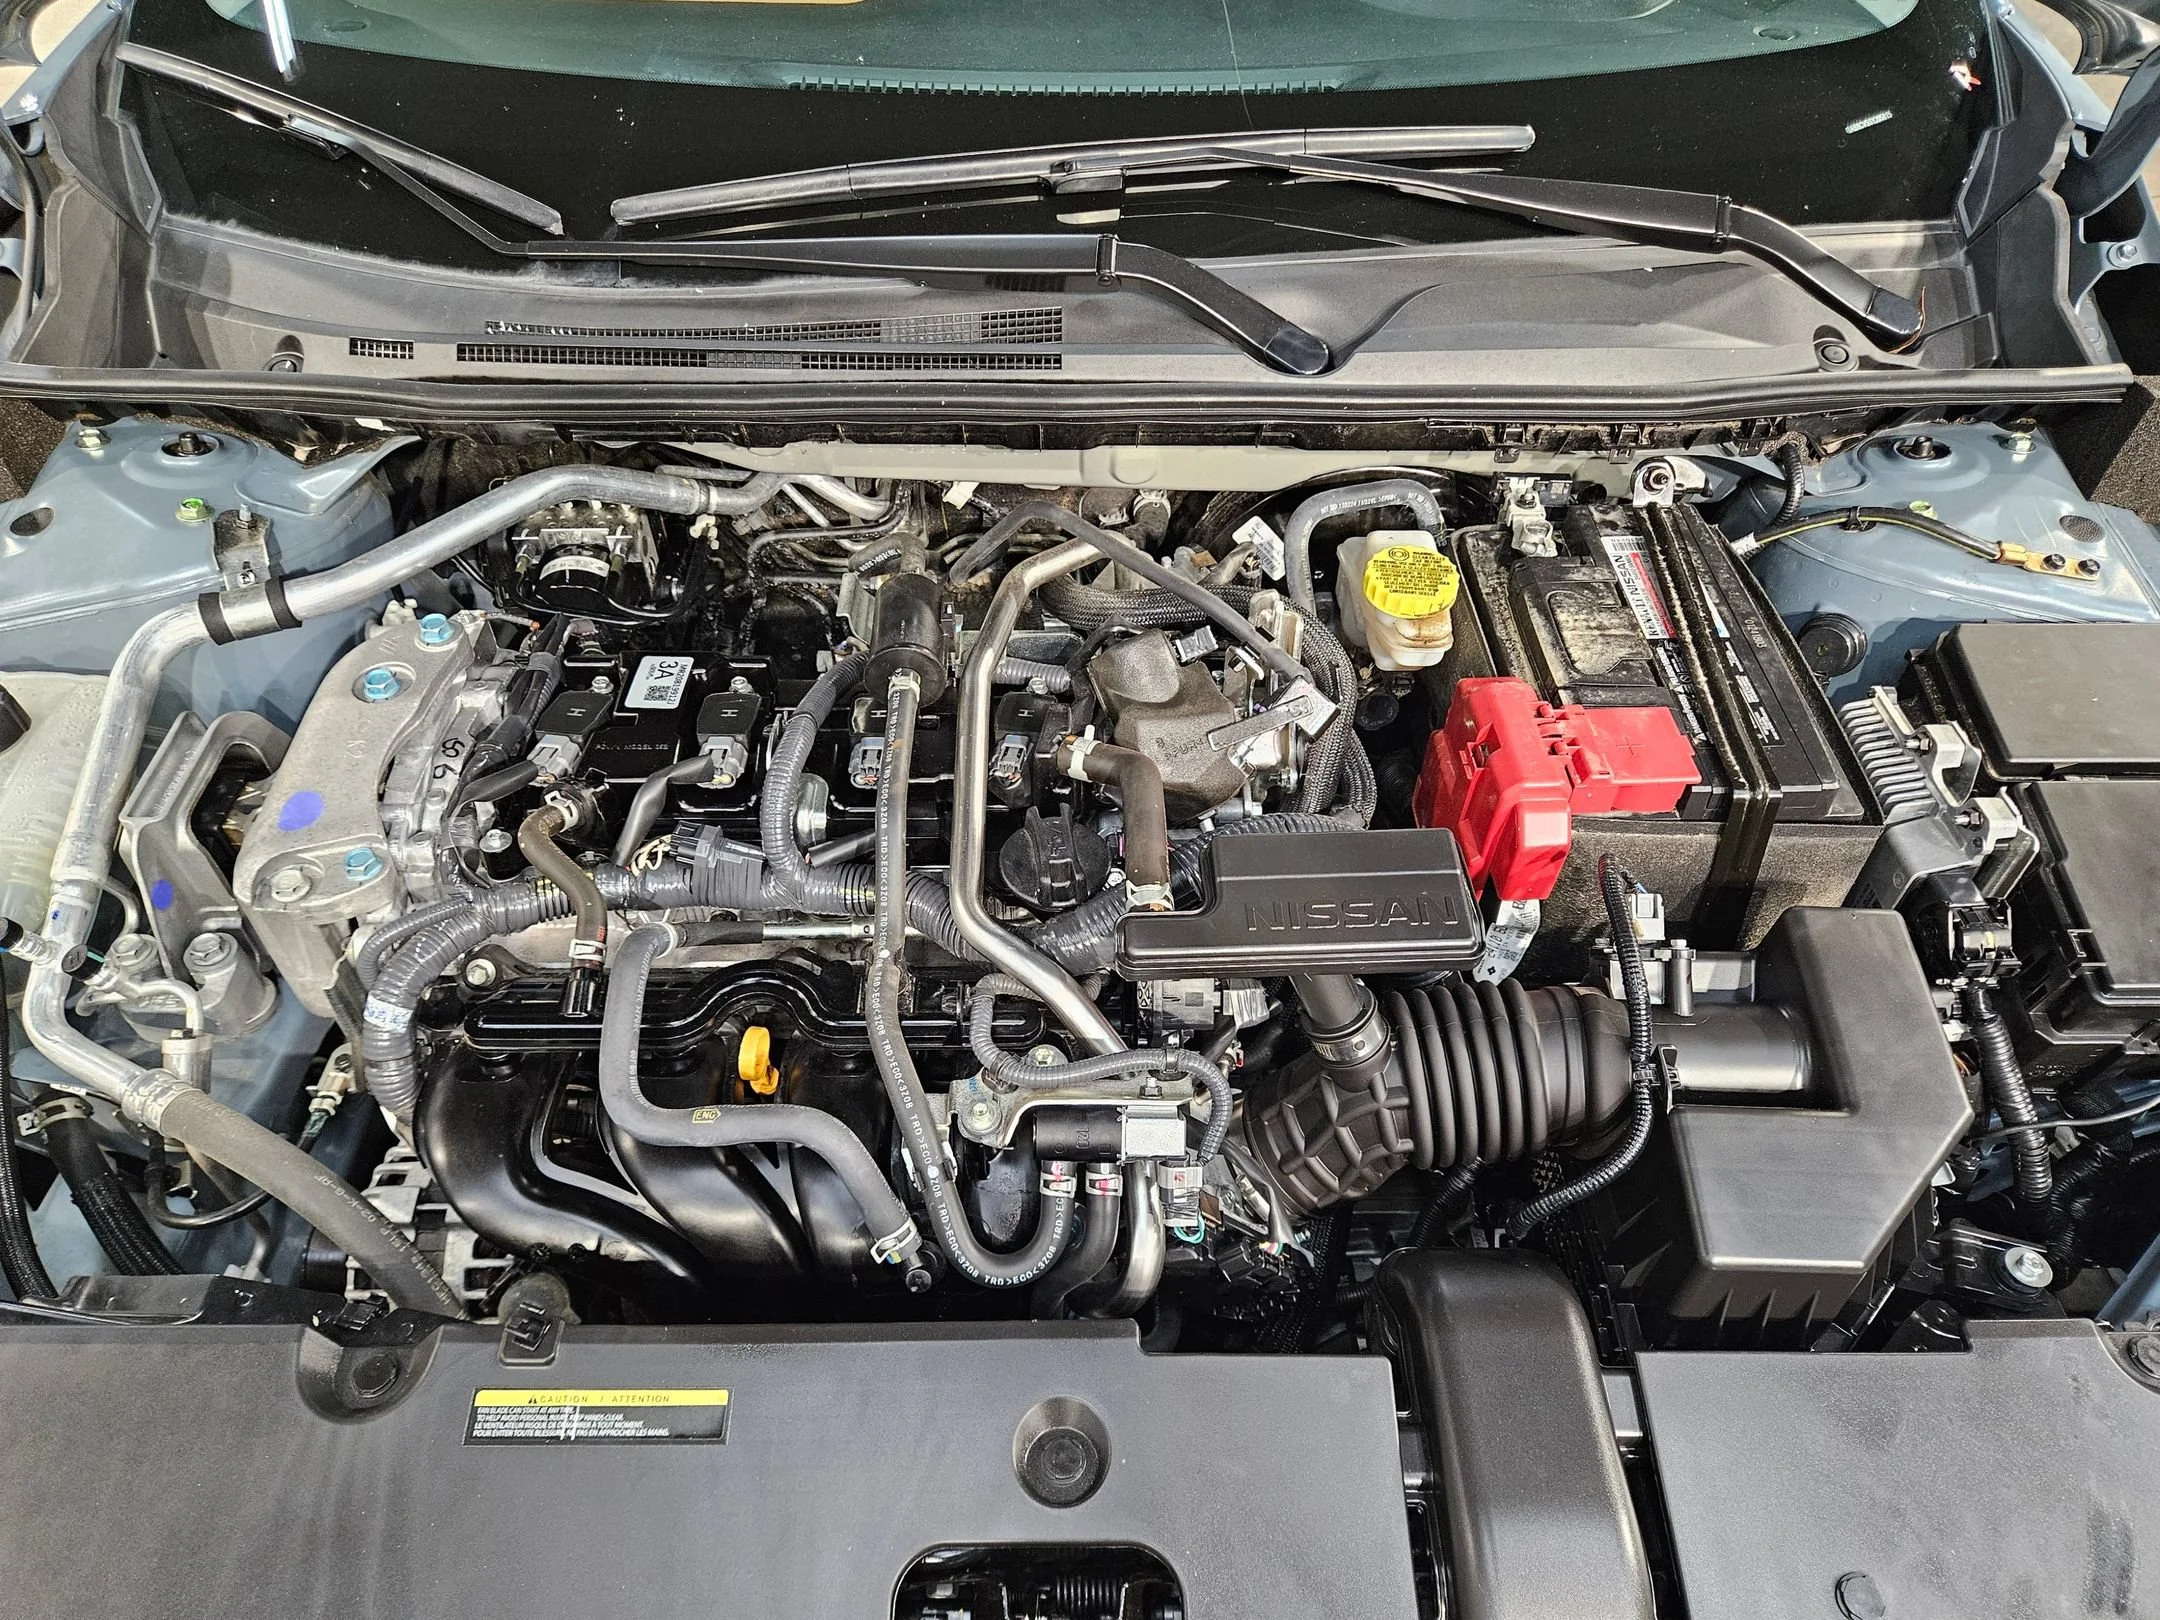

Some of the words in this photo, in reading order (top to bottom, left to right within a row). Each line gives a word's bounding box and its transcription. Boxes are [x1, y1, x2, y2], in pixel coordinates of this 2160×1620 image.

[1612, 554, 1640, 596] NISSAN
[654, 661, 678, 680] 3A
[1245, 896, 1458, 931] NISSAN
[696, 1110, 716, 1120] ENG
[612, 1395, 670, 1403] ATTENTION
